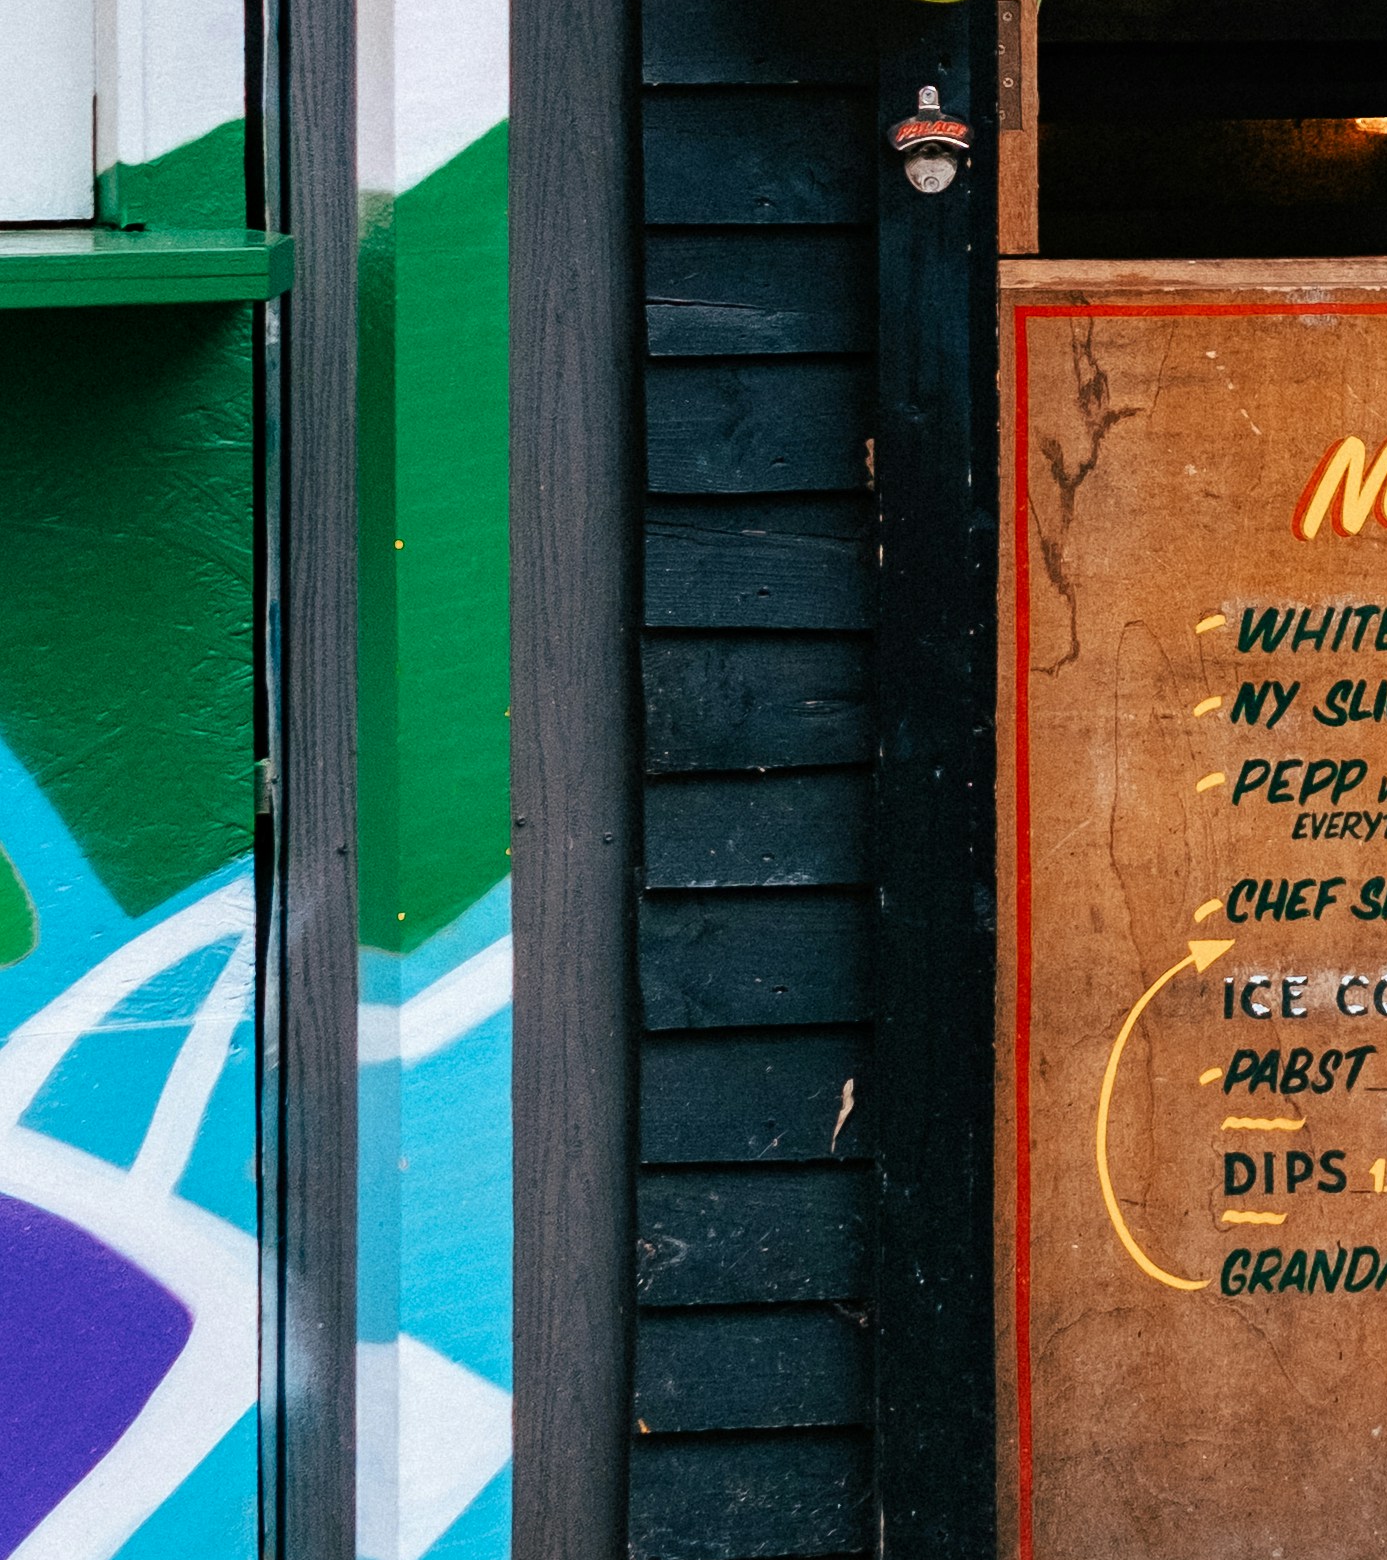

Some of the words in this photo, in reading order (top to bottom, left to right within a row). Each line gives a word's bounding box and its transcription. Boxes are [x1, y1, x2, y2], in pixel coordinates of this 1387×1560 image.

[1231, 681, 1298, 728] NY
[1233, 759, 1367, 805] PEPP
[1227, 878, 1346, 923] CHEF
[1224, 976, 1307, 1019] ICE
[1224, 1045, 1376, 1094] PABST
[1225, 1150, 1346, 1195] DIPS
